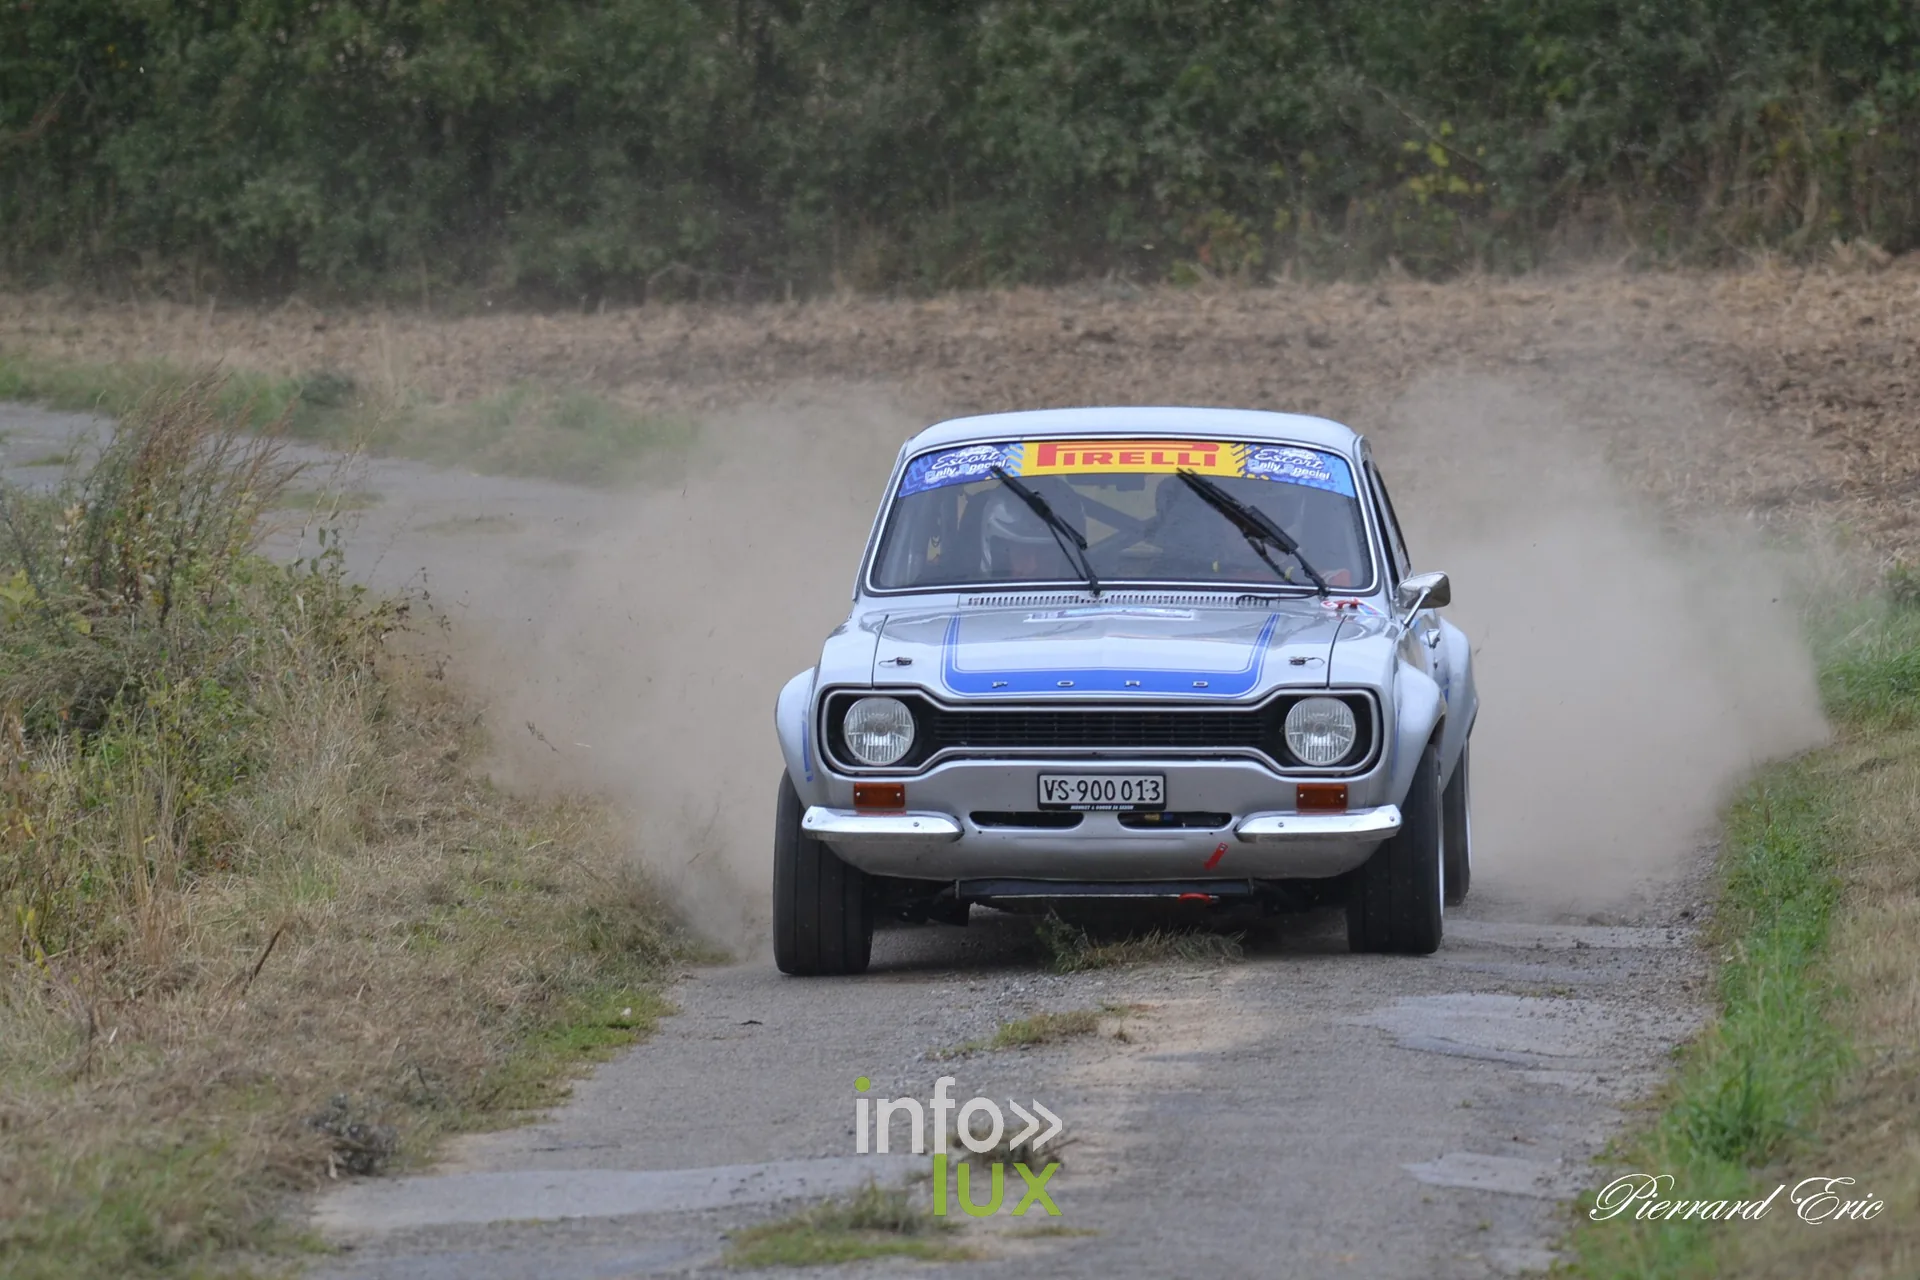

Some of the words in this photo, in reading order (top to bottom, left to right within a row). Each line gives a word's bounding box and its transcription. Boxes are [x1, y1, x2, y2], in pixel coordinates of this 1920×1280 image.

[931, 450, 1001, 470] Escort
[1037, 442, 1220, 467] PIRELLI
[1254, 448, 1325, 470] Escort
[992, 680, 1209, 689] FORD
